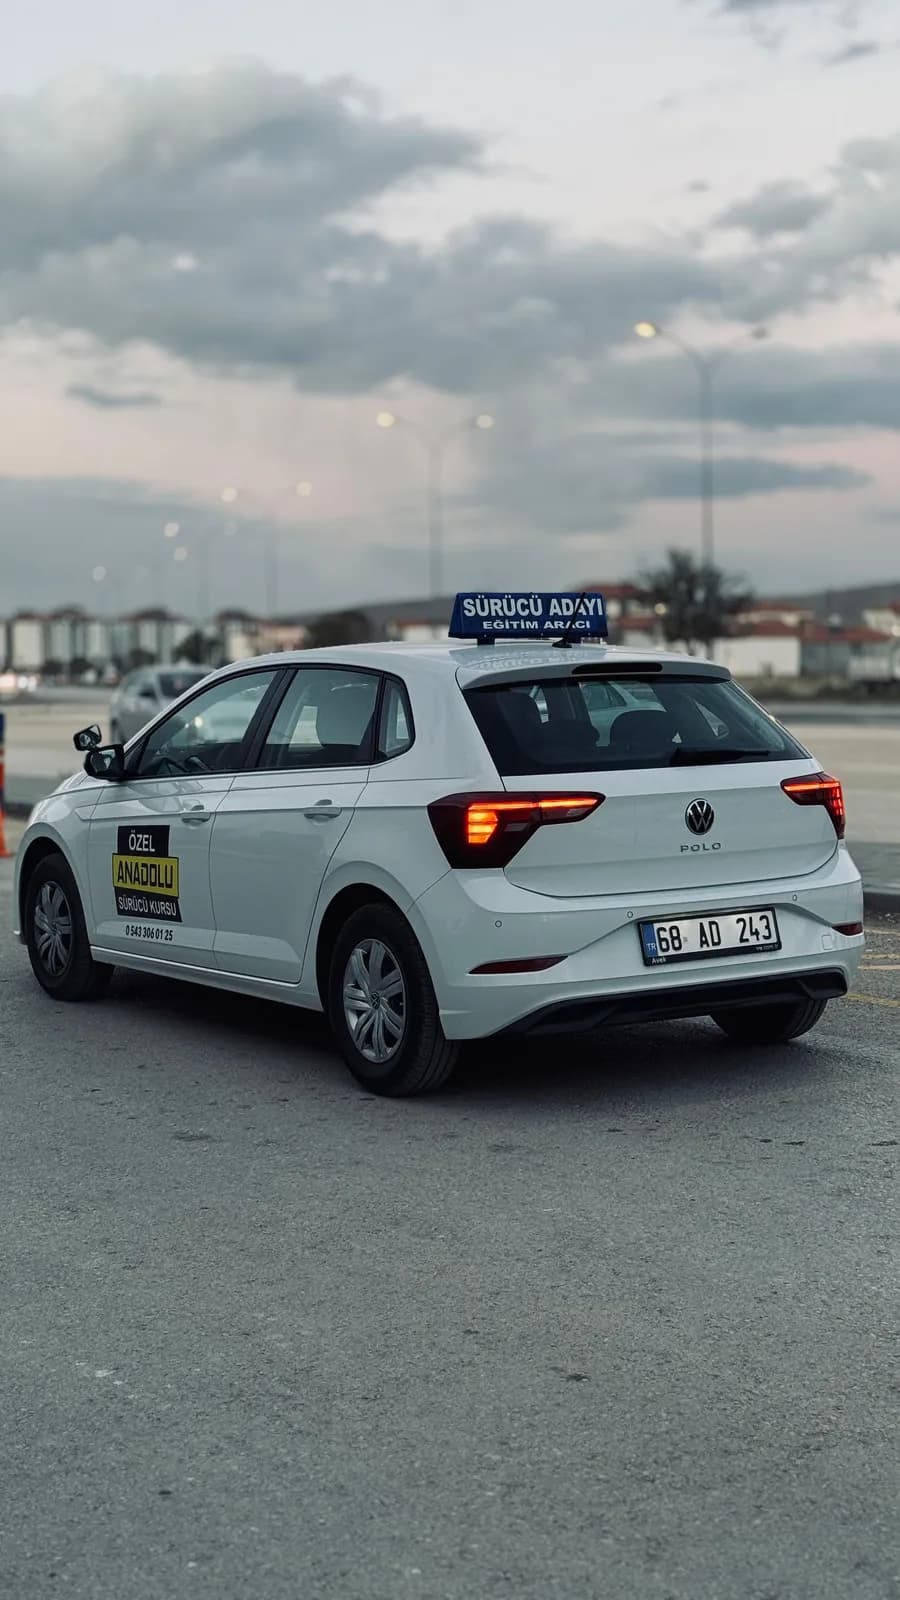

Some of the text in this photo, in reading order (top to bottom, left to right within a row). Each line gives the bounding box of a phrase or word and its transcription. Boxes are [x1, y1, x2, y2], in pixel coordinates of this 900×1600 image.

[463, 595, 603, 617] SÜRÜCÜ ADAYI
[482, 619, 591, 630] EĞİTİM ARACI
[128, 830, 155, 852] ÖZEL
[680, 842, 721, 853] POLO
[117, 860, 173, 888] ANADOLU
[118, 894, 177, 917] SÜRÜCÜ KURSU
[125, 924, 173, 941] 0 543 306 01 25
[656, 914, 772, 952] 68 AD 243
[646, 943, 657, 952] TR
